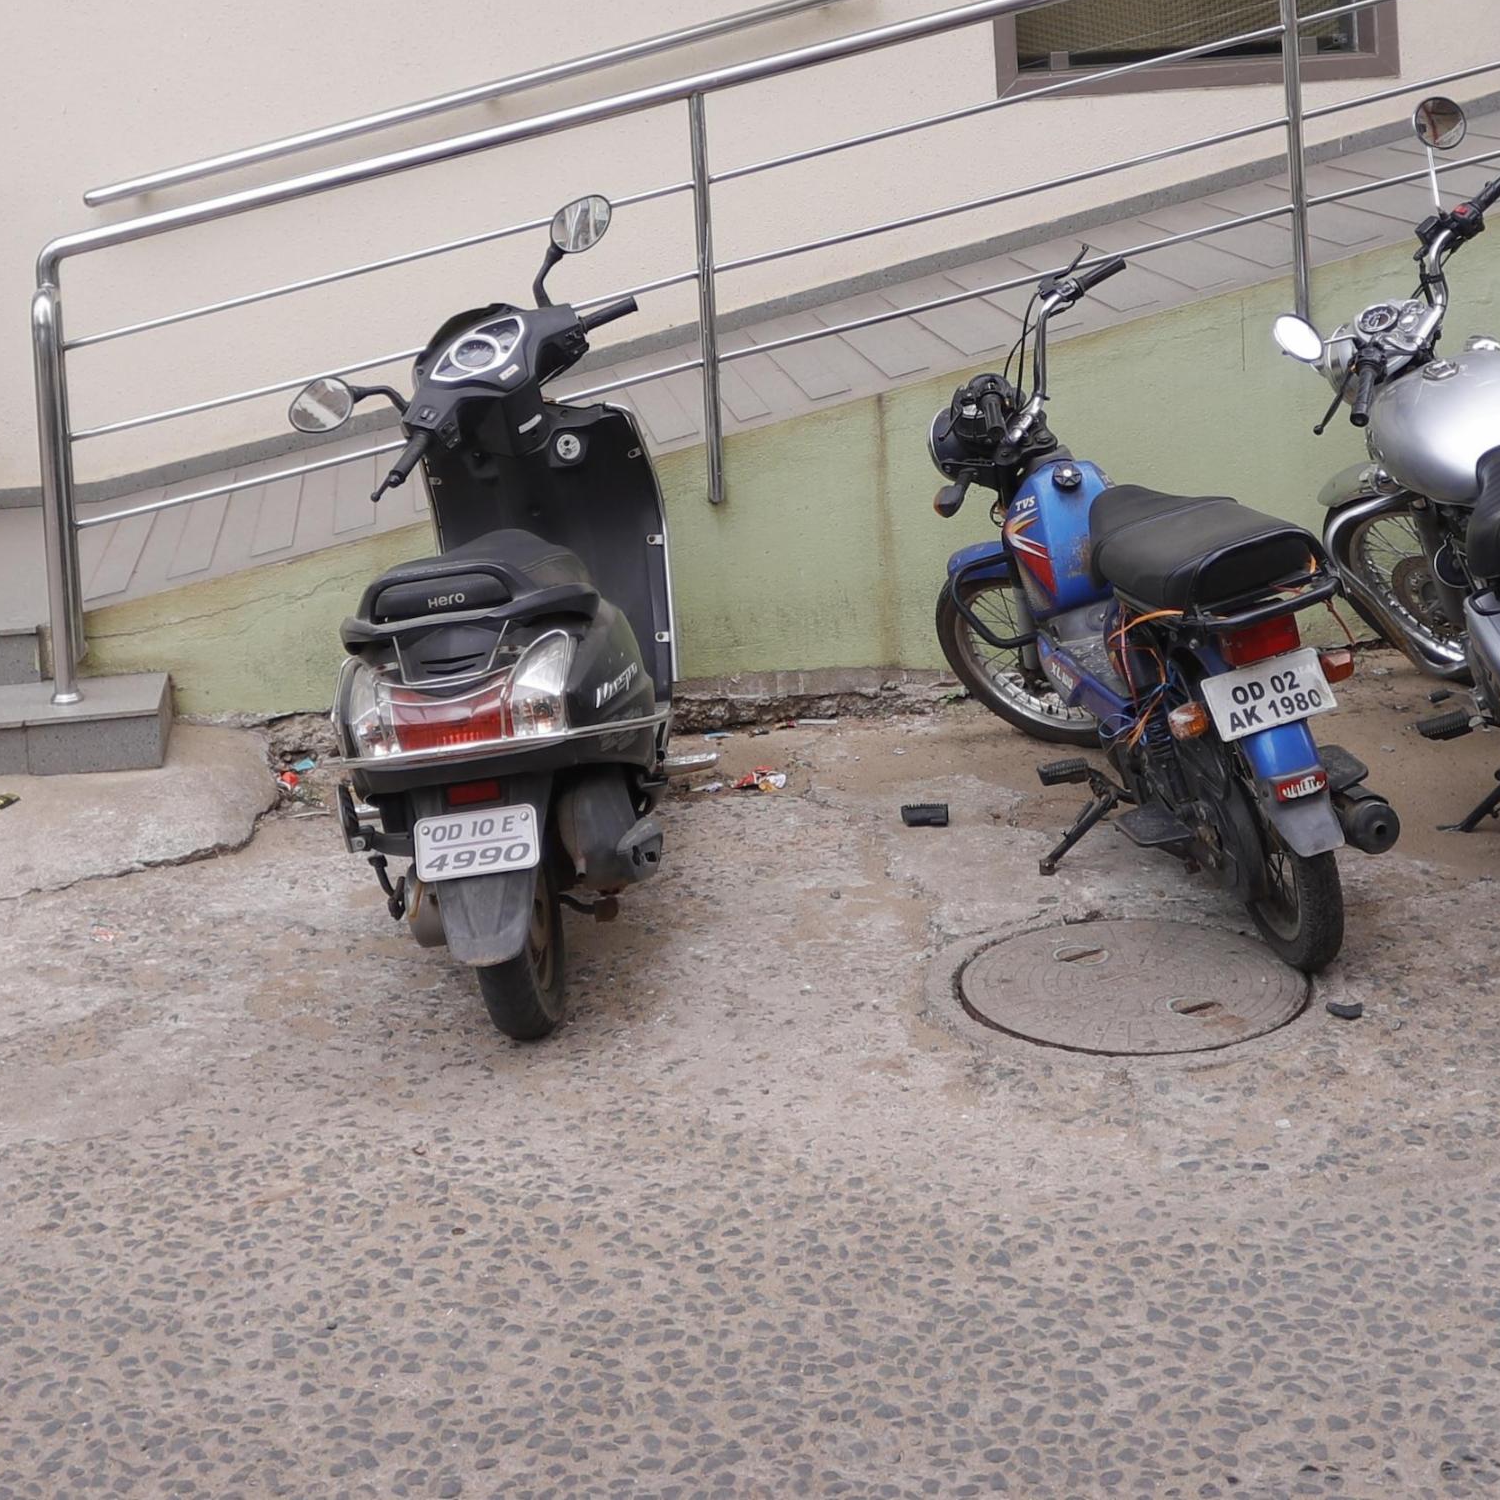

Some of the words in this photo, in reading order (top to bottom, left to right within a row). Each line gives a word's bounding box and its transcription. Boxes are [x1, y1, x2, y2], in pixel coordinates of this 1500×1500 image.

[1015, 495, 1036, 512] TVS
[1231, 681, 1265, 705] OD
[1270, 671, 1300, 694] 02
[1230, 704, 1263, 732] AK
[1268, 689, 1322, 718] 1980
[431, 823, 462, 842] OD
[471, 819, 494, 837] 10
[501, 815, 515, 833] E
[425, 842, 530, 872] 4990
